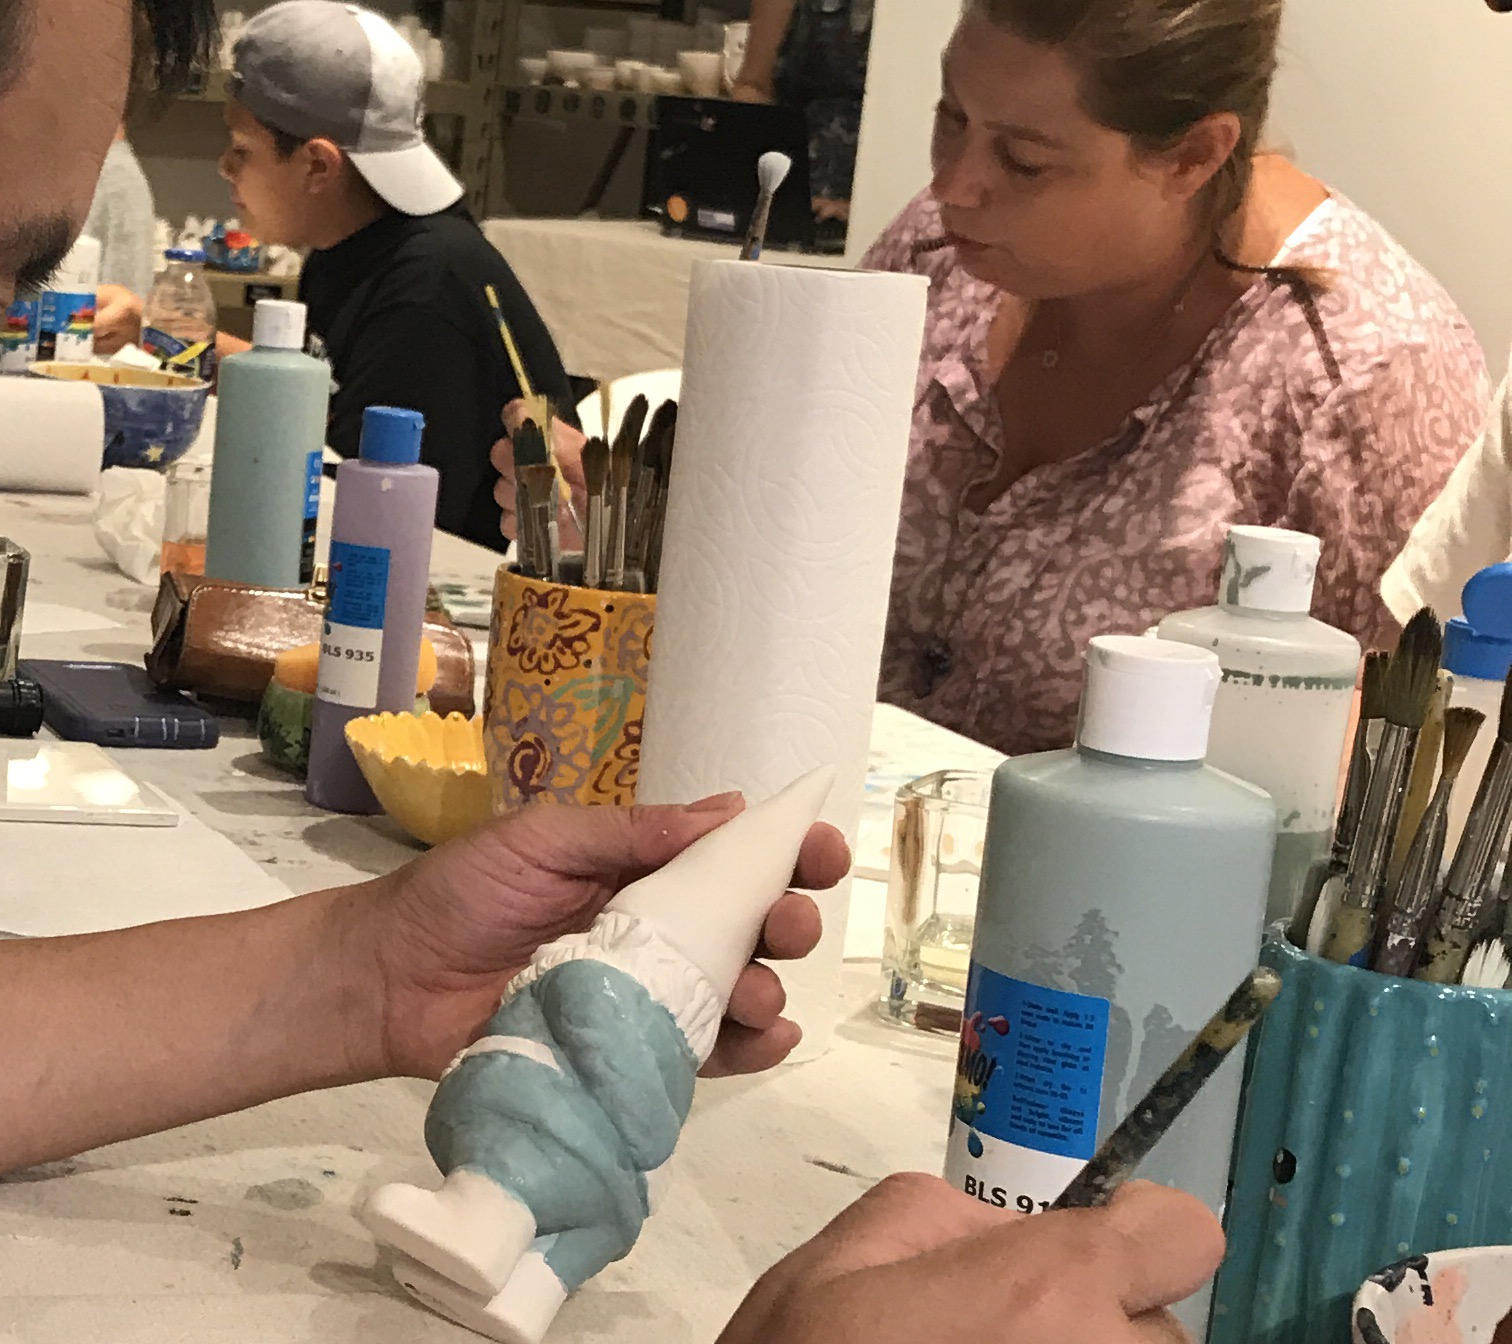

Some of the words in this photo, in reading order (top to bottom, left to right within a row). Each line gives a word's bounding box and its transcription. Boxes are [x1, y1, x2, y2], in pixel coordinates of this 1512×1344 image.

[346, 649, 374, 662] 935
[965, 1174, 1007, 1208] BLS
[1017, 1195, 1049, 1214] 91
